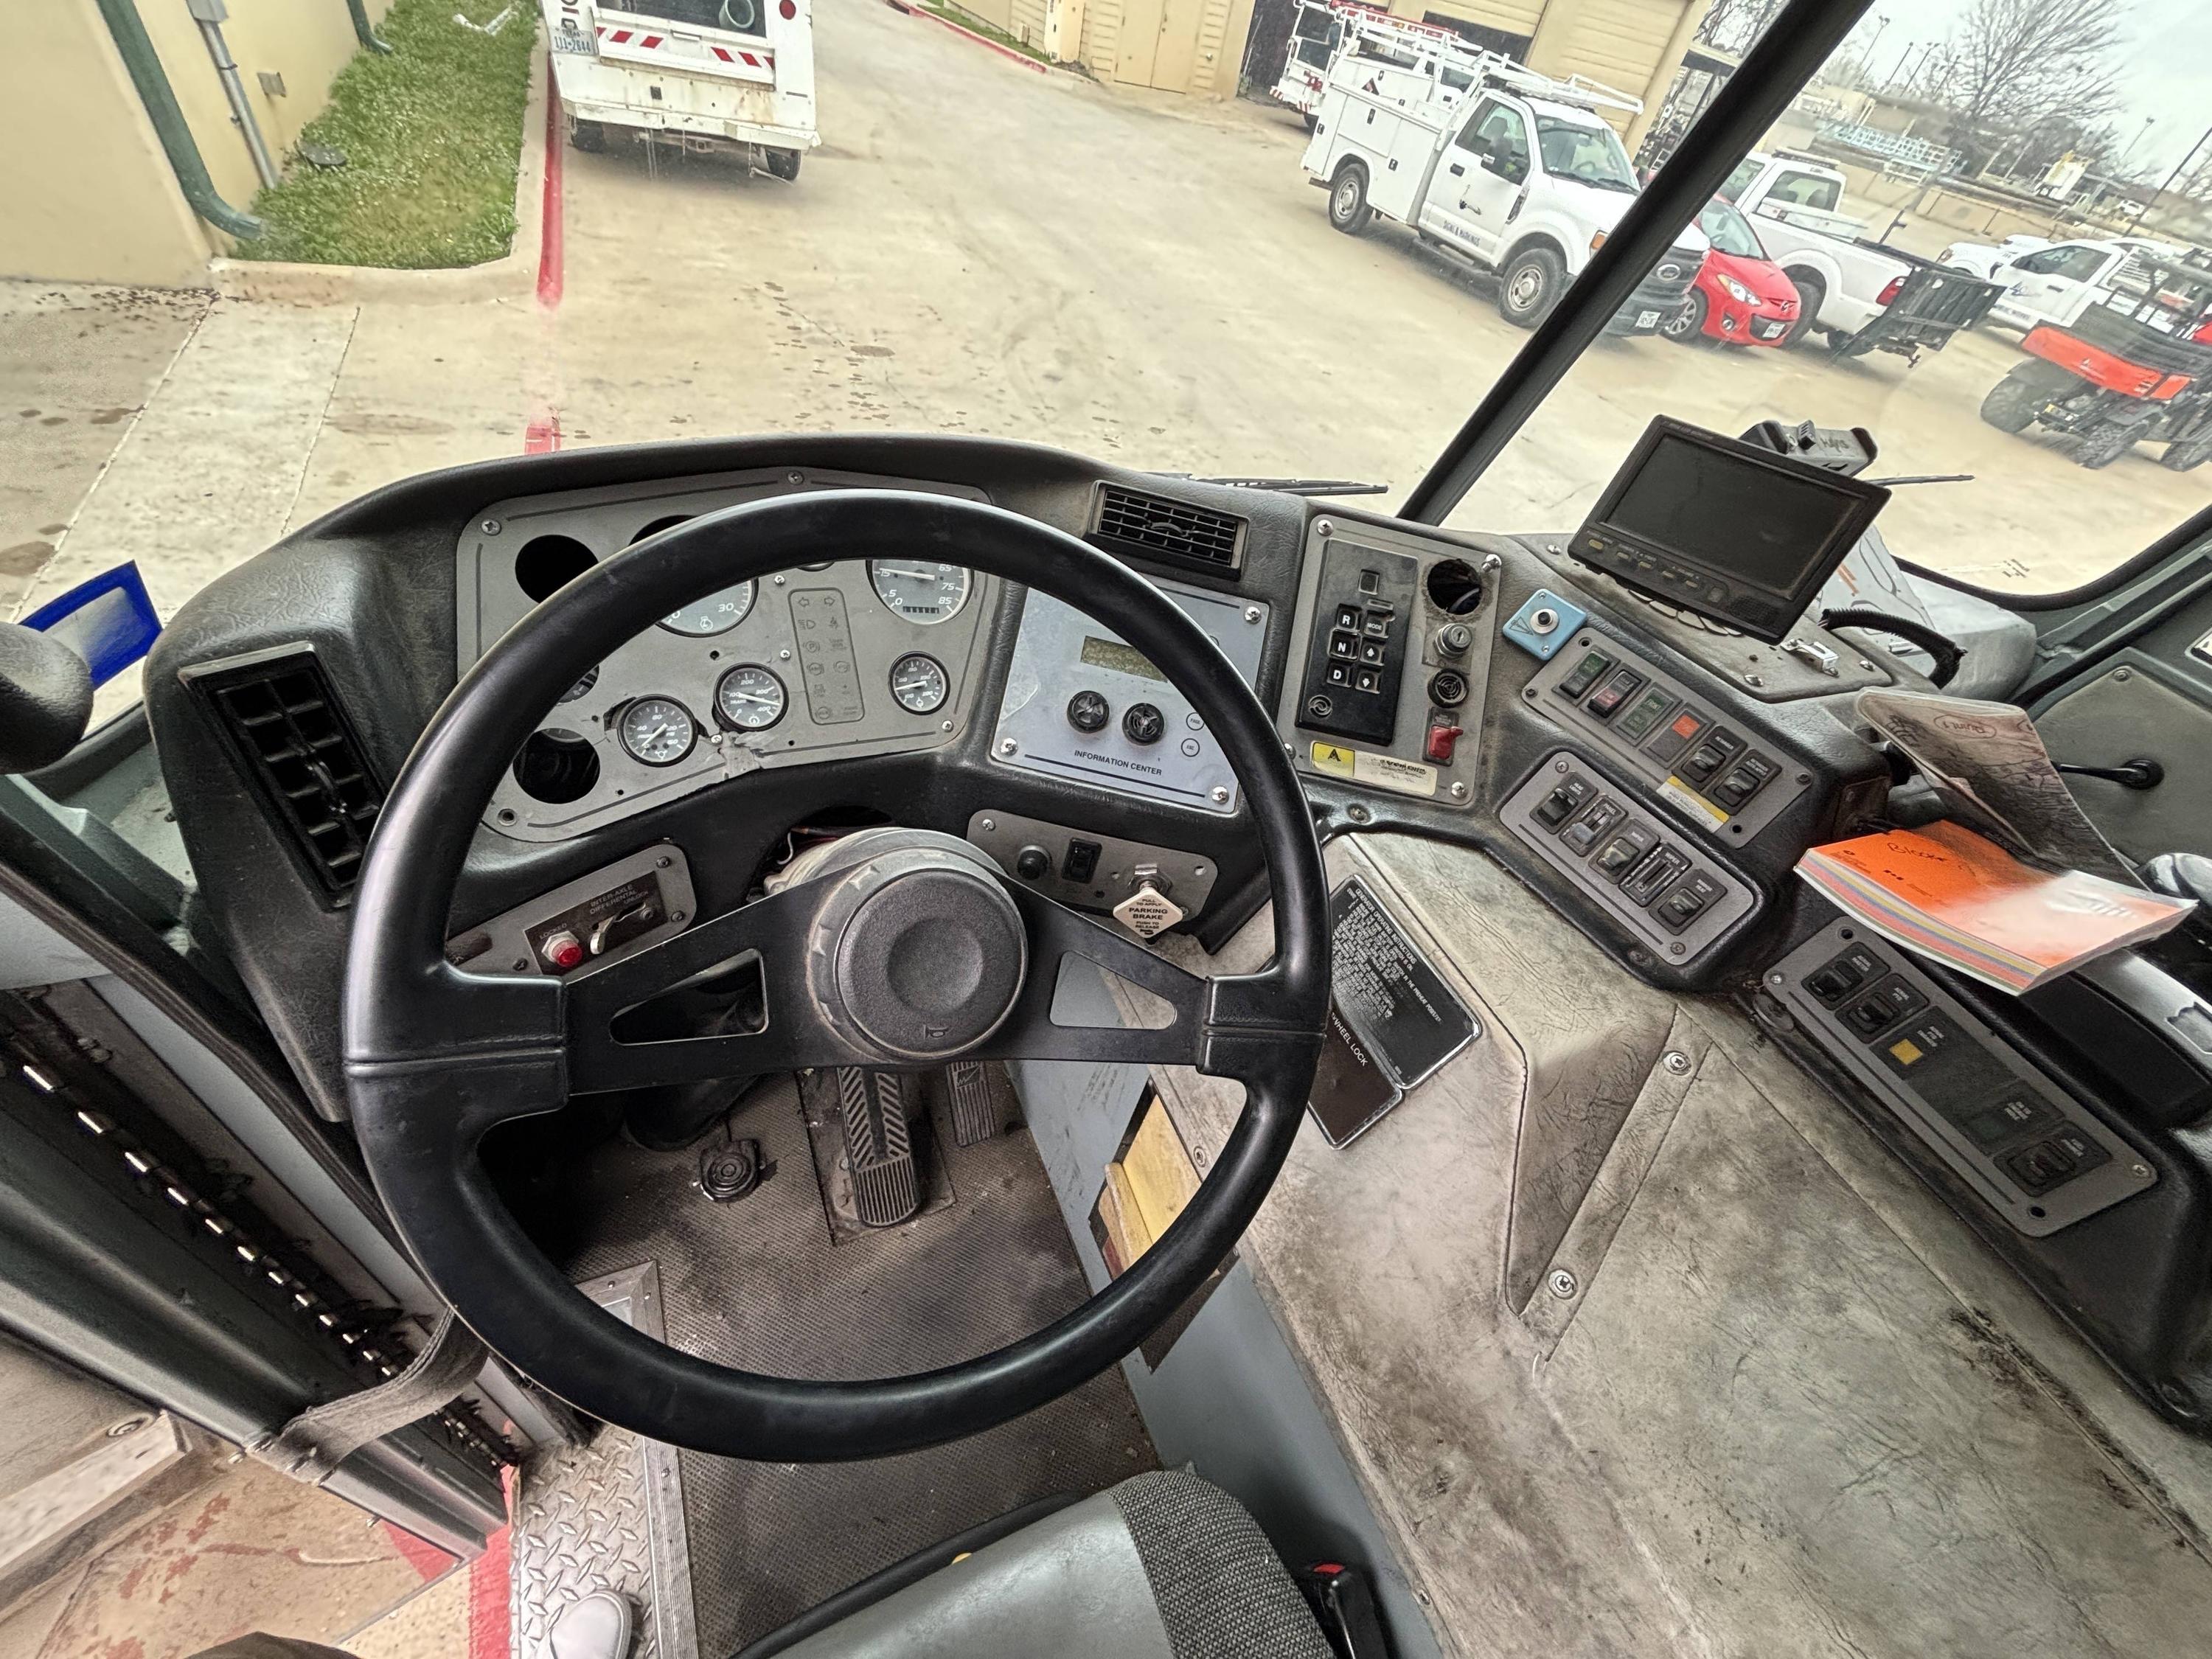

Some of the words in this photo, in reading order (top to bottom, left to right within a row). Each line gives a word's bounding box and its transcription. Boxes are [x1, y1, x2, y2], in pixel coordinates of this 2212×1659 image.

[942, 582, 956, 591] 75
[888, 589, 897, 597] 5
[894, 597, 903, 605] 0
[938, 597, 953, 605] 85
[718, 602, 734, 613] 30
[1342, 614, 1351, 625] R
[1367, 622, 1382, 630] MODE
[1338, 641, 1346, 653] N
[1333, 669, 1342, 680] D
[1074, 750, 1129, 768] INFORMATION
[1130, 762, 1162, 776] CENTER
[1367, 914, 1375, 922] THE
[1354, 887, 1376, 912] GENERATOR
[1372, 910, 1394, 935] OPERATING
[1390, 932, 1417, 964] INSTRUCTIONS
[1406, 979, 1415, 989] THE
[1412, 987, 1427, 1005] PREHEAT
[1349, 1043, 1369, 1066] LOCK
